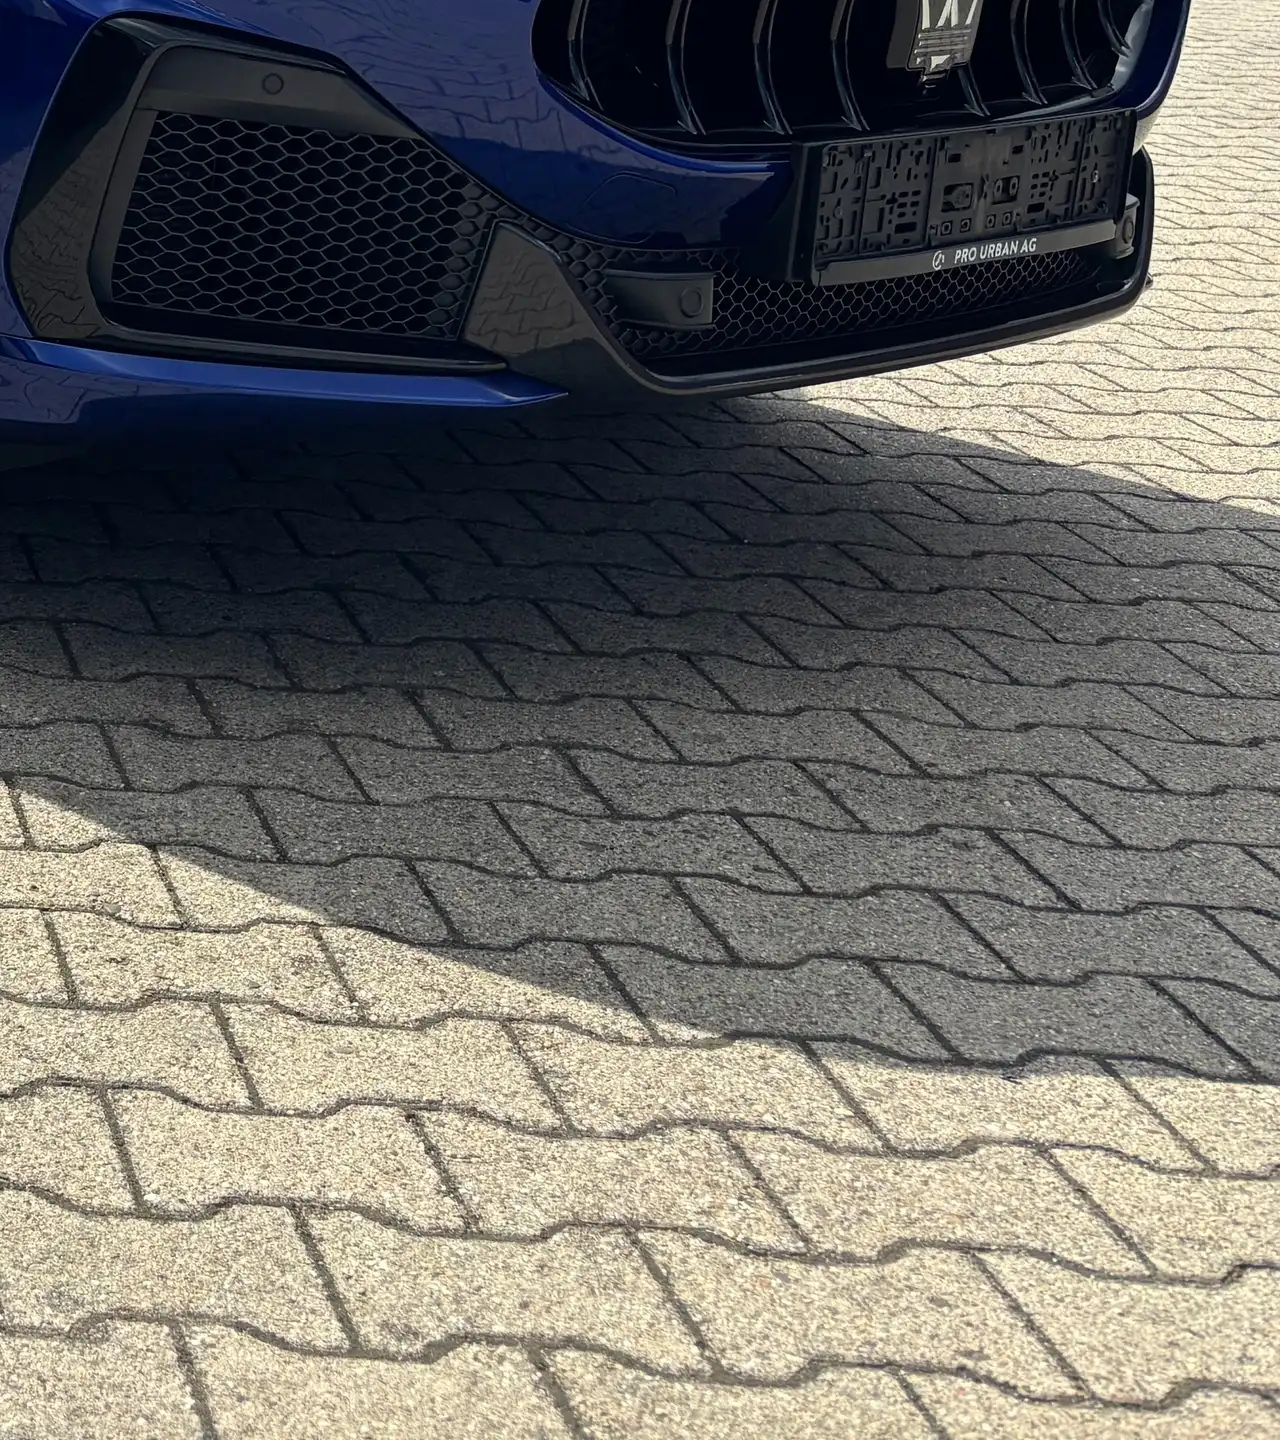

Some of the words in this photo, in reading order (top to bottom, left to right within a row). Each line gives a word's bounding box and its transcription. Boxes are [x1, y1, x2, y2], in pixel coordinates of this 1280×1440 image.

[954, 247, 977, 264] PRO
[980, 240, 1019, 260] URBAN
[1020, 237, 1037, 254] AG
